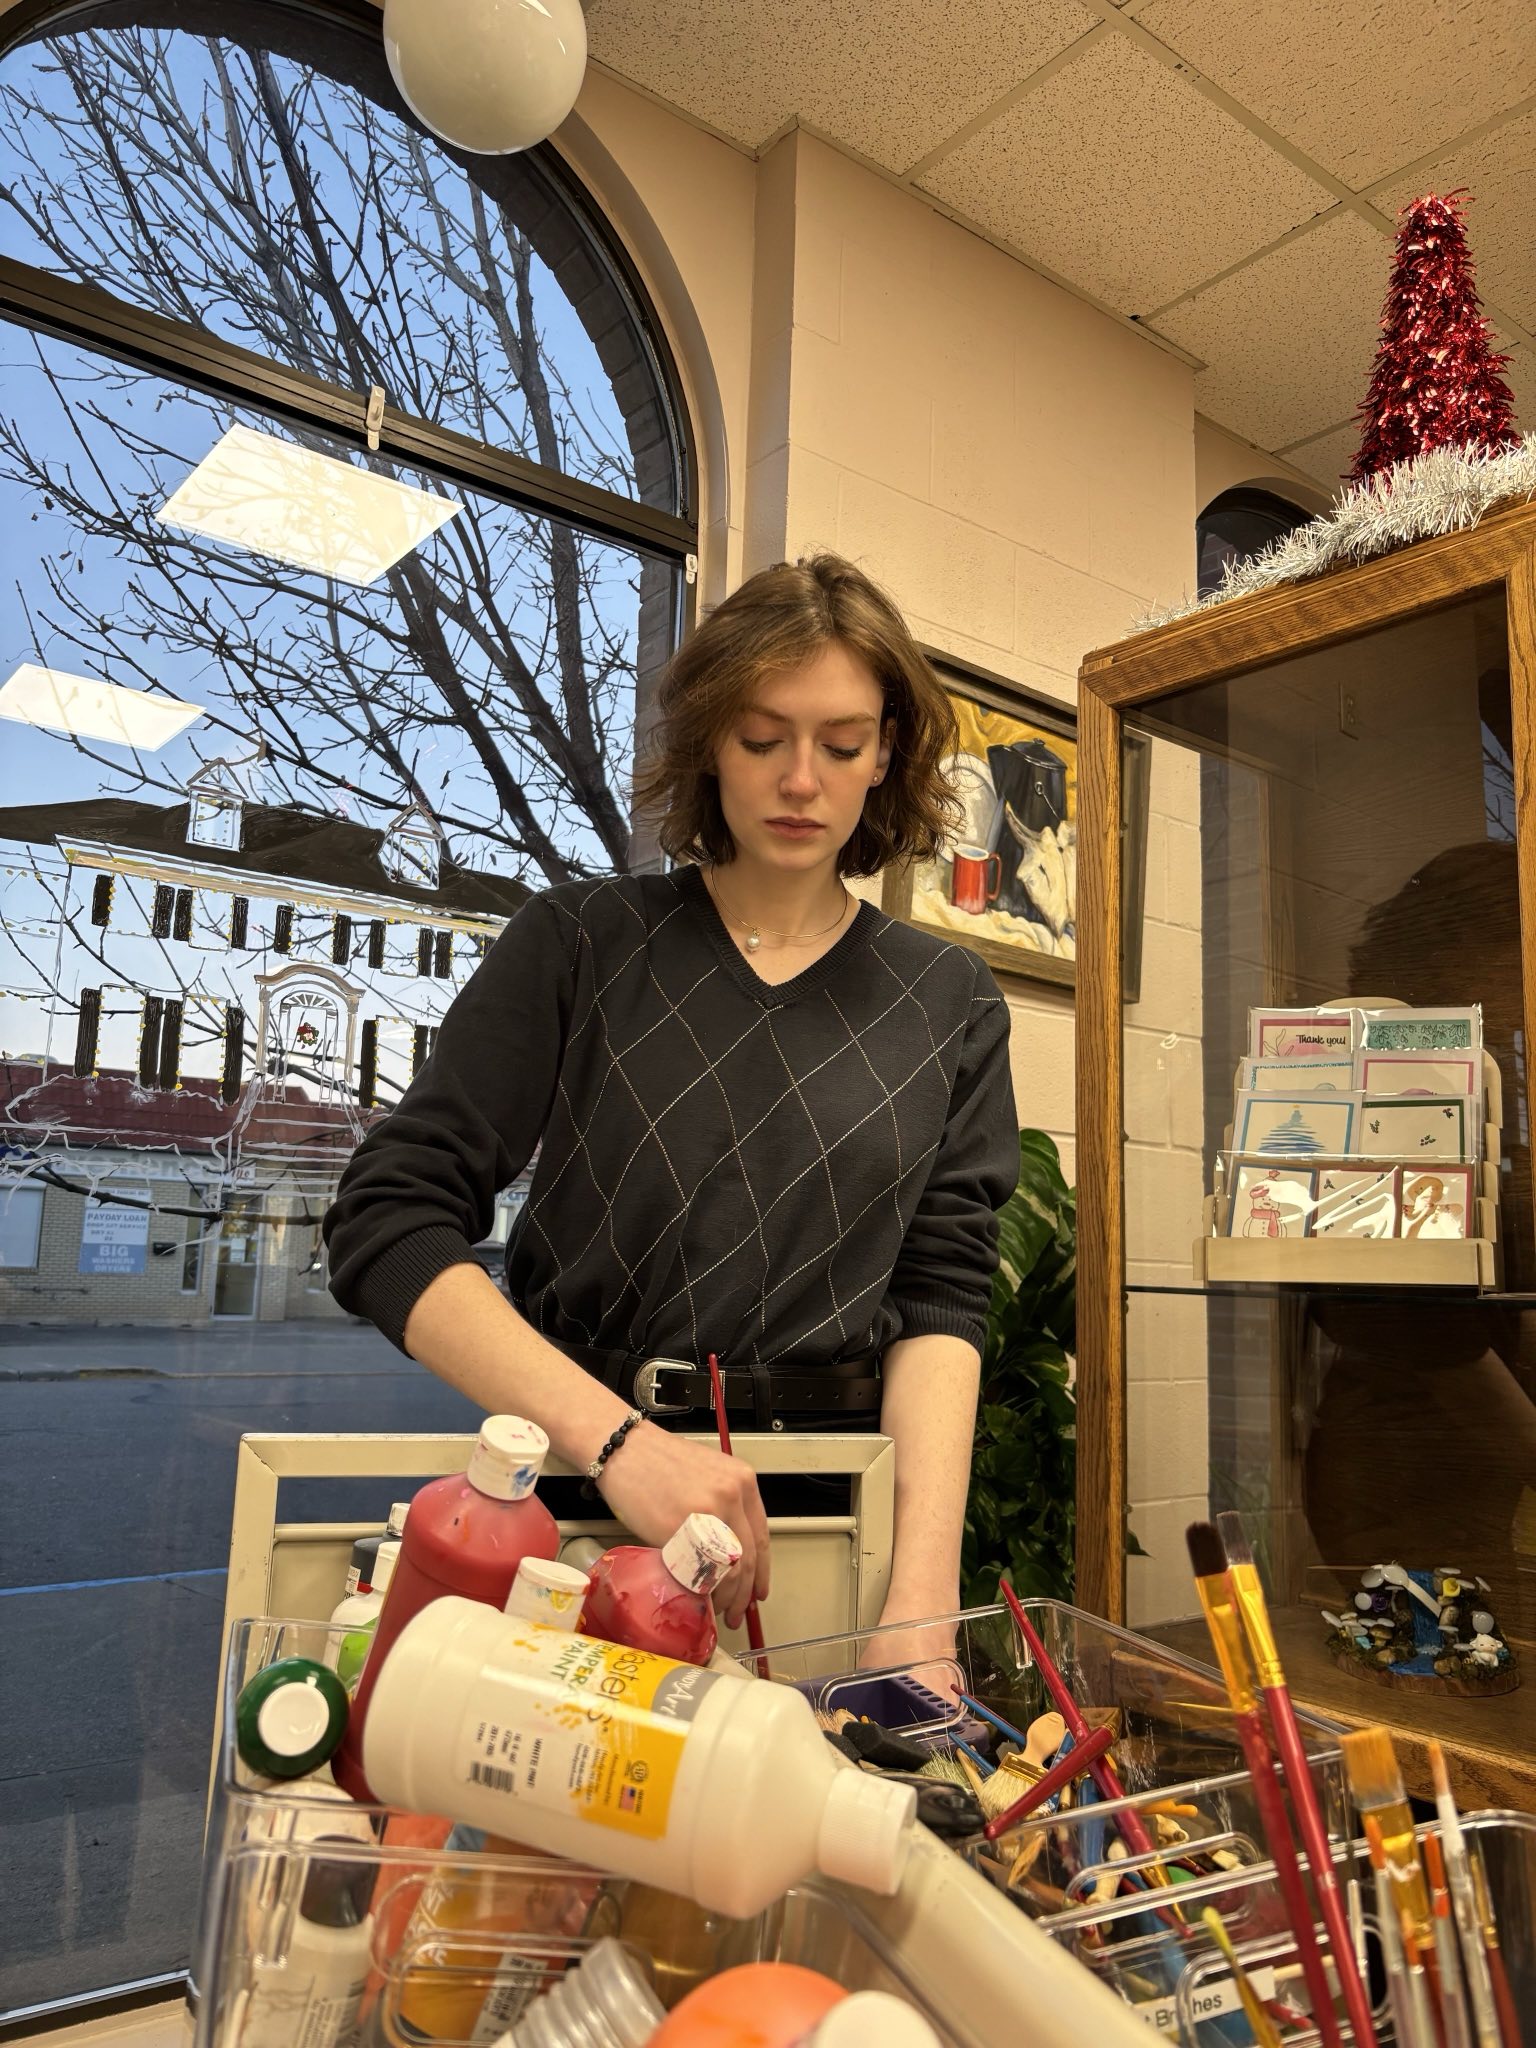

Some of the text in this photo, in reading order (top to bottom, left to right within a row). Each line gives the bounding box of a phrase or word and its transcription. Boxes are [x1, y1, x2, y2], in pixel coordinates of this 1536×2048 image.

[1296, 1034, 1324, 1044] Thank
[87, 1212, 148, 1222] PAYDAY LOAN
[99, 1245, 130, 1257] BIG
[550, 1640, 589, 1681] PAINT
[529, 1738, 543, 1767] WHITE
[1155, 1994, 1222, 2027] Brhes
